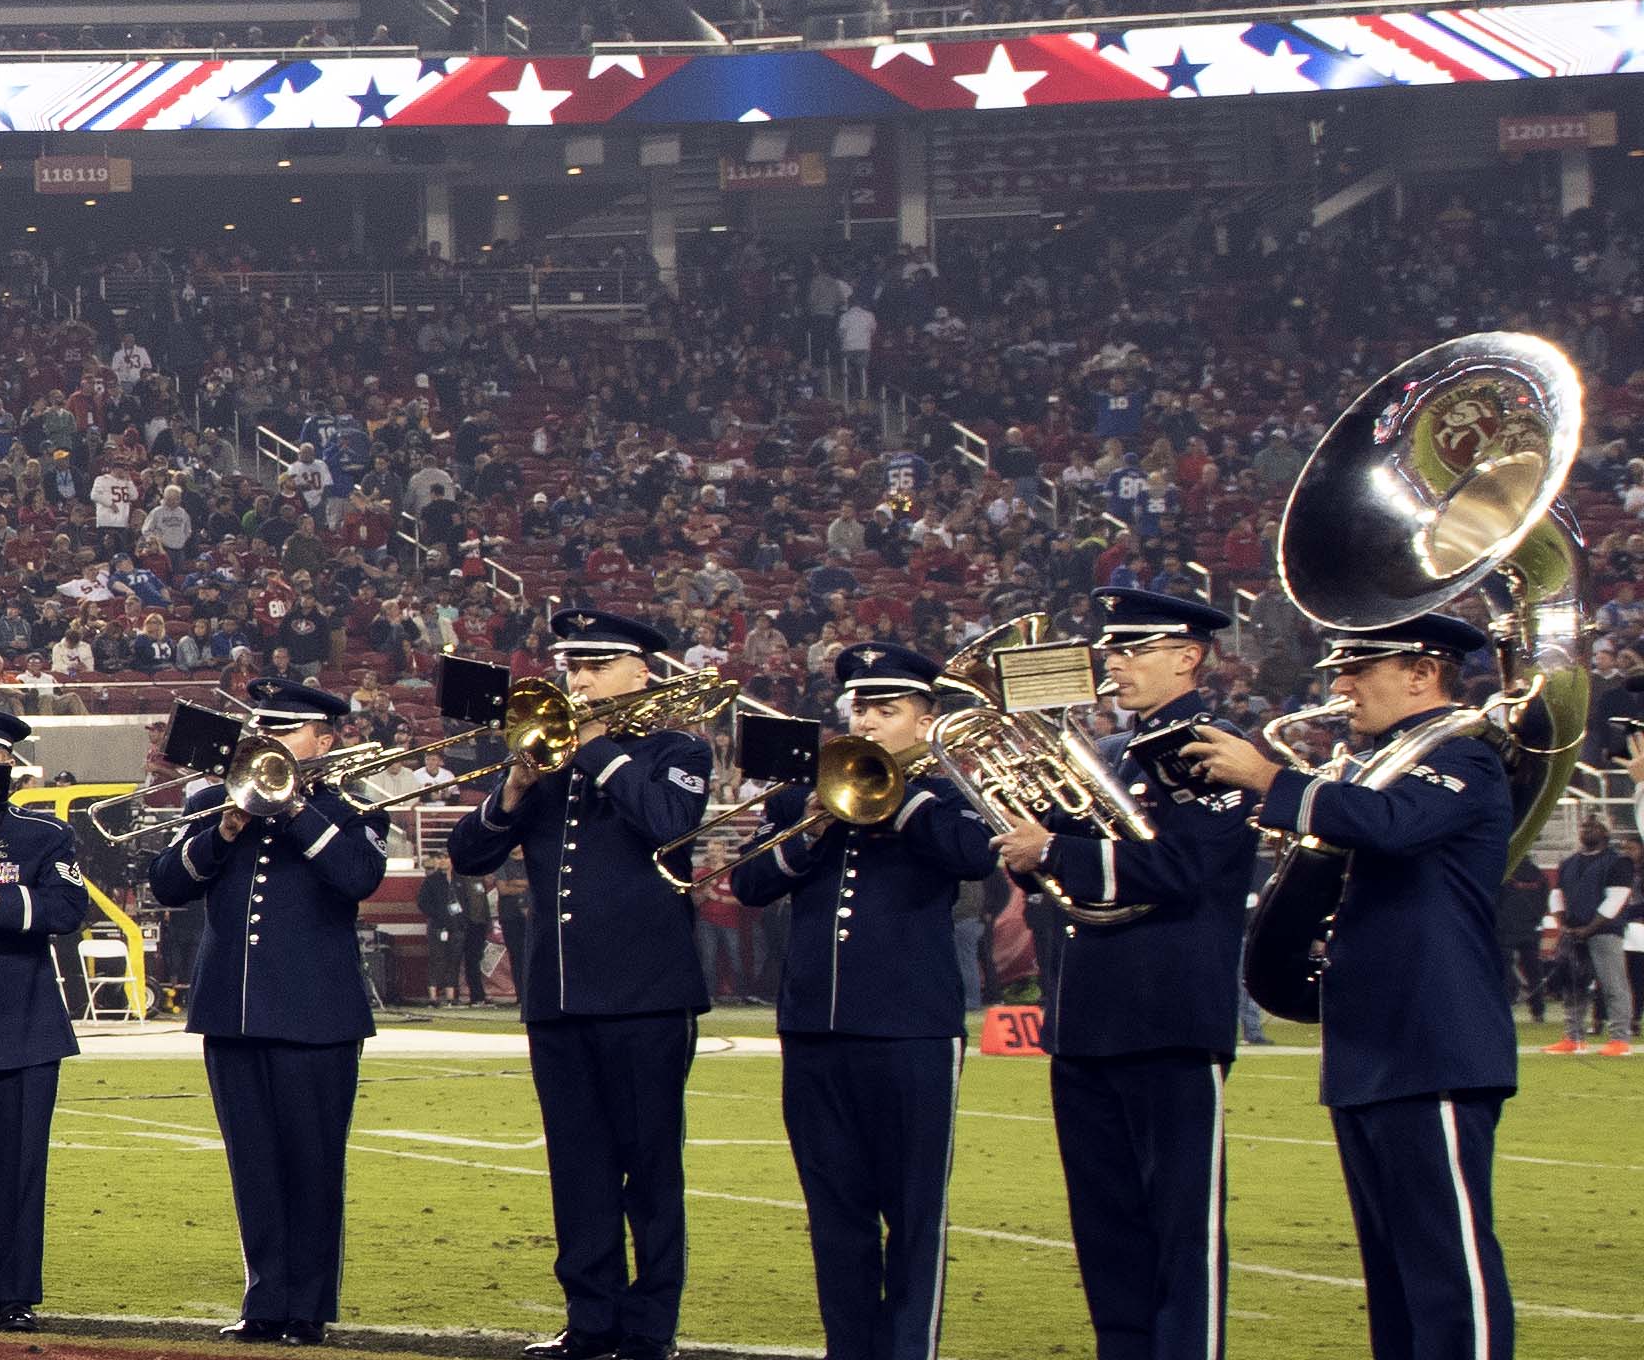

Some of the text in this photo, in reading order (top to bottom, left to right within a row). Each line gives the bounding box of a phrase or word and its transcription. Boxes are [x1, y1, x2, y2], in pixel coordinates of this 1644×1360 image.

[42, 168, 108, 182] 118 119
[111, 486, 129, 503] 56
[269, 601, 286, 617] 80
[997, 1014, 1045, 1048] 30
